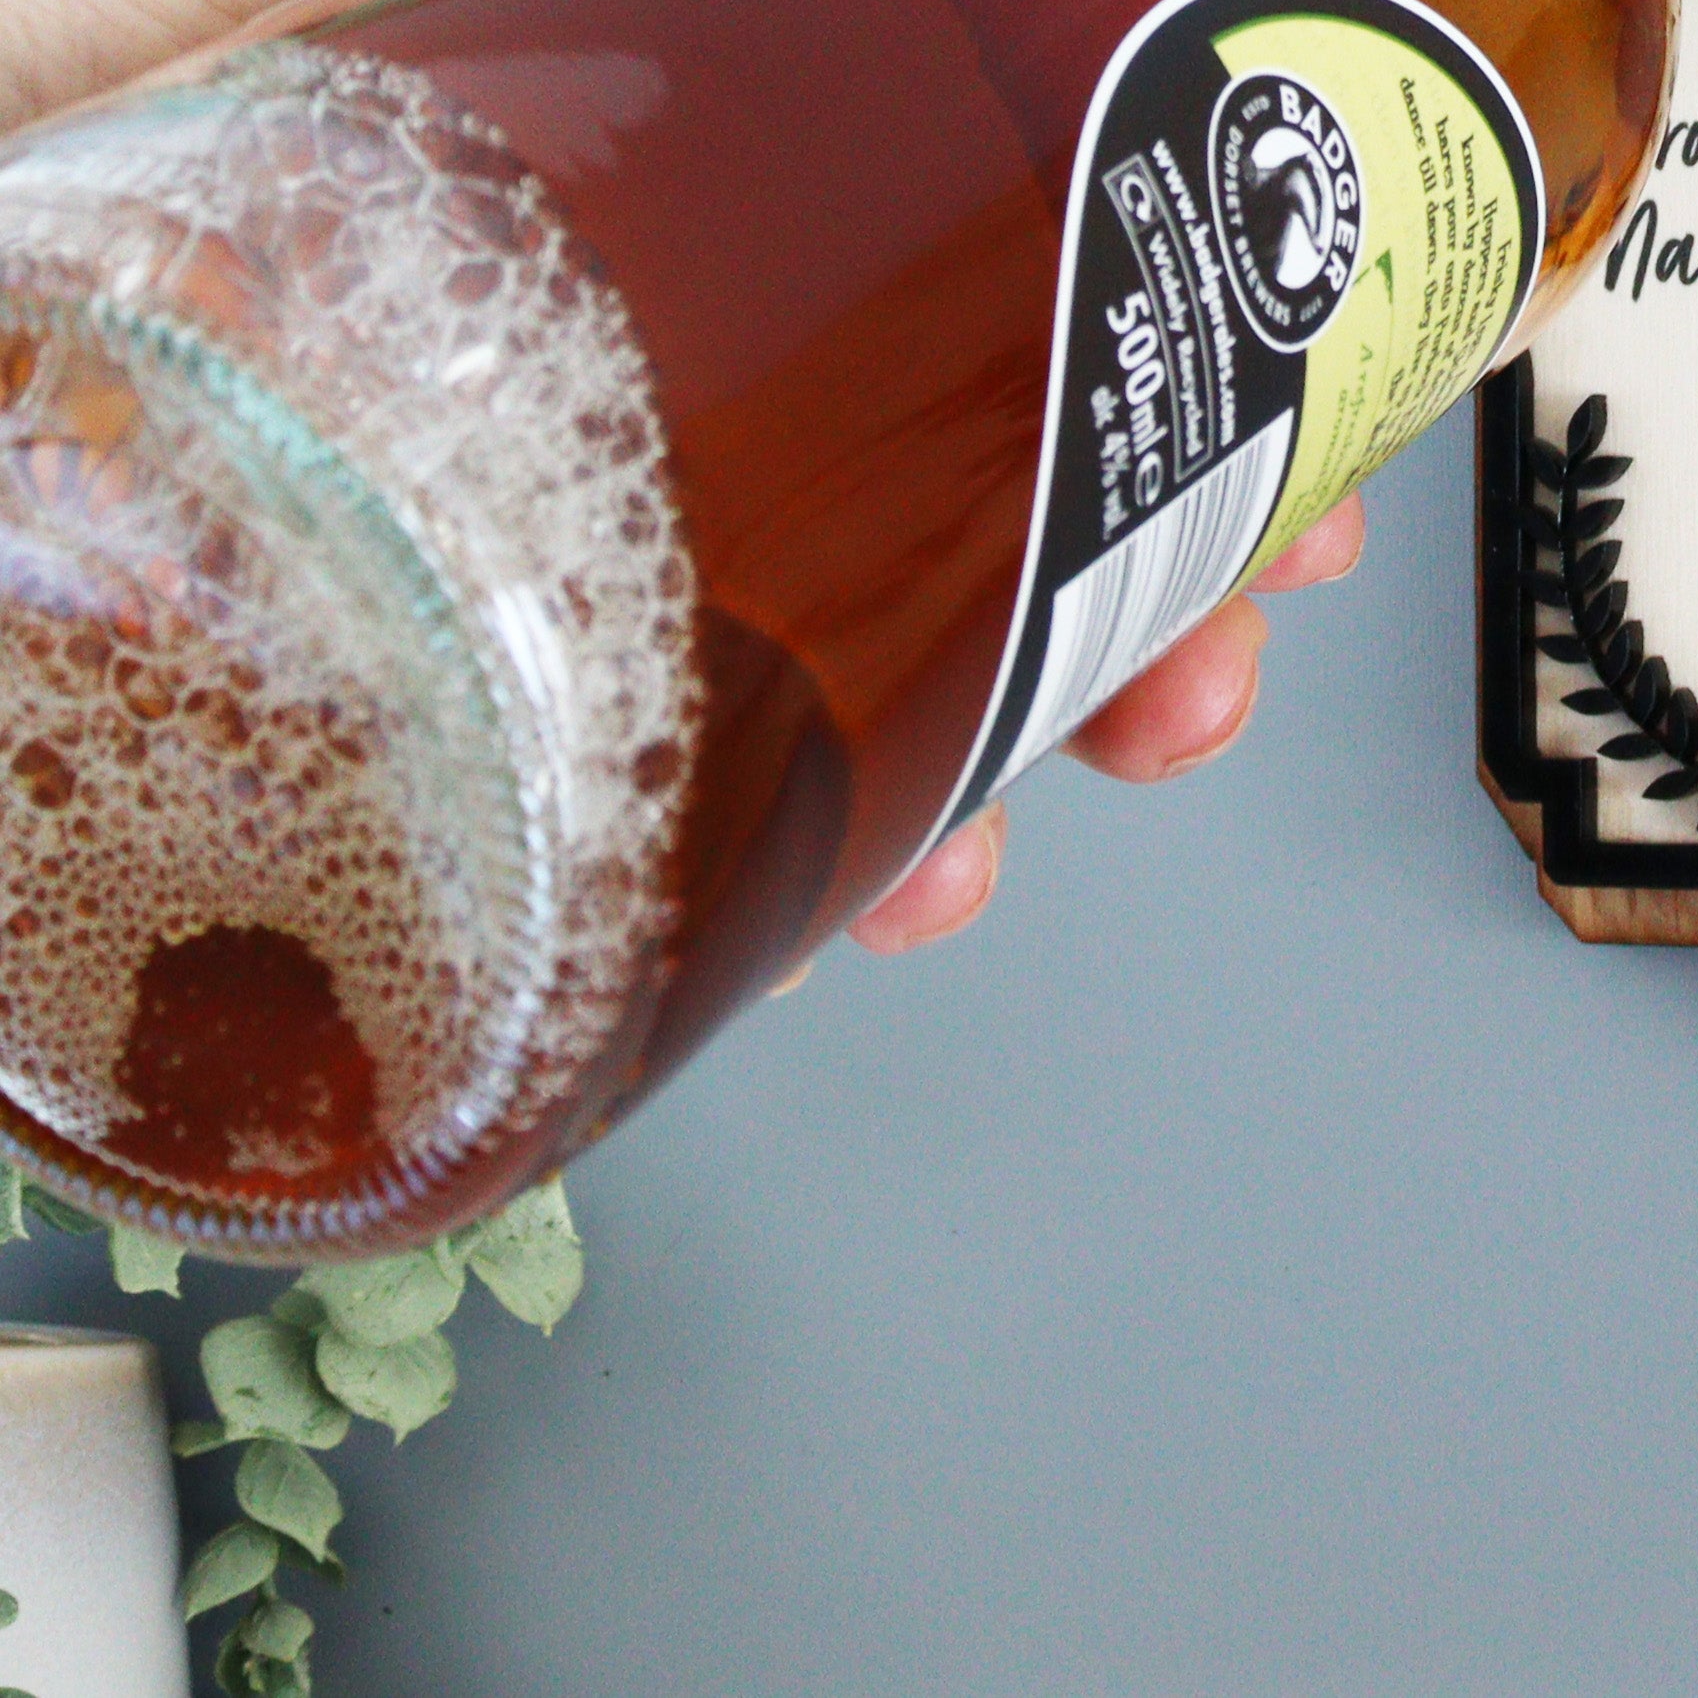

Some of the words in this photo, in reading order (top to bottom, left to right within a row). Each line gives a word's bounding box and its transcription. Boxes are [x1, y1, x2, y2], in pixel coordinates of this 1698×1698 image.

[1224, 124, 1245, 228] DORSET
[1399, 76, 1427, 152] dance
[1418, 154, 1438, 195] till
[1435, 115, 1455, 191] hares
[1461, 133, 1476, 219] known
[1278, 83, 1358, 293] BADGER
[1442, 194, 1457, 252] pour
[1462, 219, 1480, 252] by
[1152, 138, 1238, 448] www.badgerales.com
[1234, 234, 1292, 327] BREWERS
[1149, 229, 1189, 332] Widely
[1177, 335, 1205, 459] Recycled
